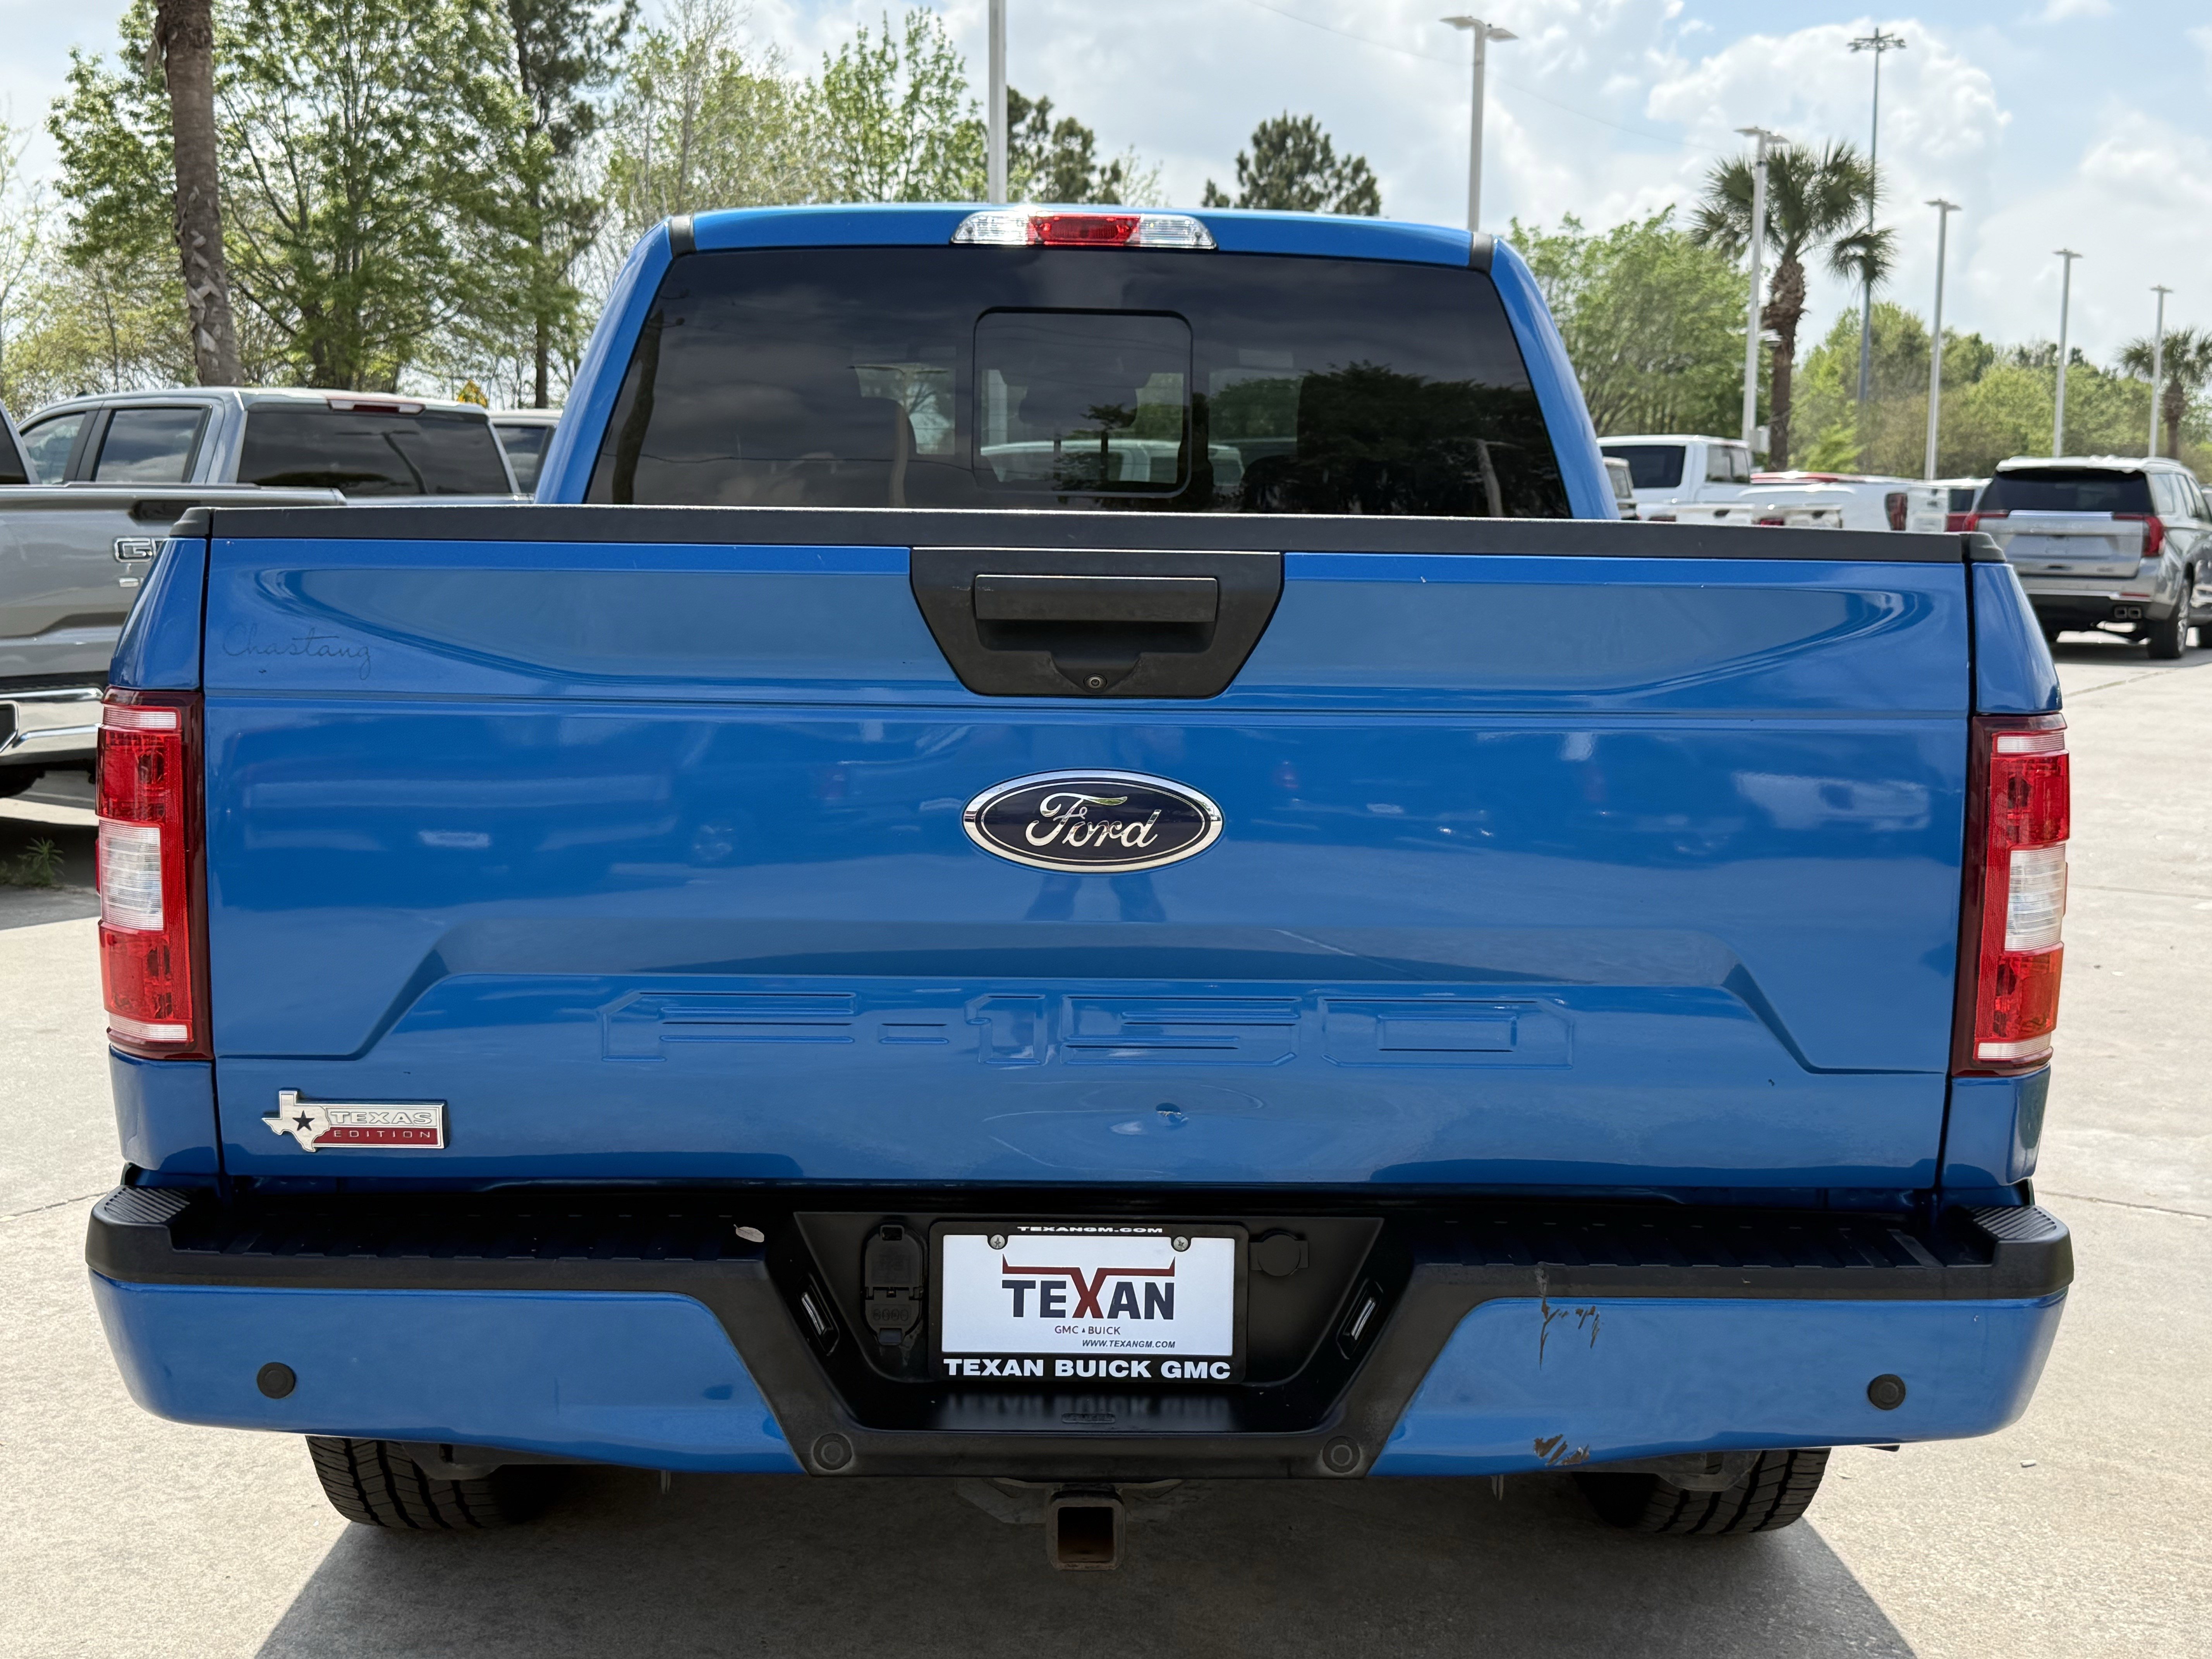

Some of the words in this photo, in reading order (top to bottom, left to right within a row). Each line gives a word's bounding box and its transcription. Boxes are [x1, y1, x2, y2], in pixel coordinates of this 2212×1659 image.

[1025, 792, 1161, 848] Ford
[330, 1111, 432, 1125] TEXAS
[1002, 1267, 1175, 1320] TEXAN
[1054, 1325, 1079, 1334] GMC
[1088, 1326, 1121, 1335] BUICK
[1082, 1340, 1175, 1348] WWW.TEXANGM.COM
[943, 1358, 1044, 1376] TEXAN
[1055, 1359, 1152, 1378] BUICK
[1161, 1360, 1230, 1379] GMC
